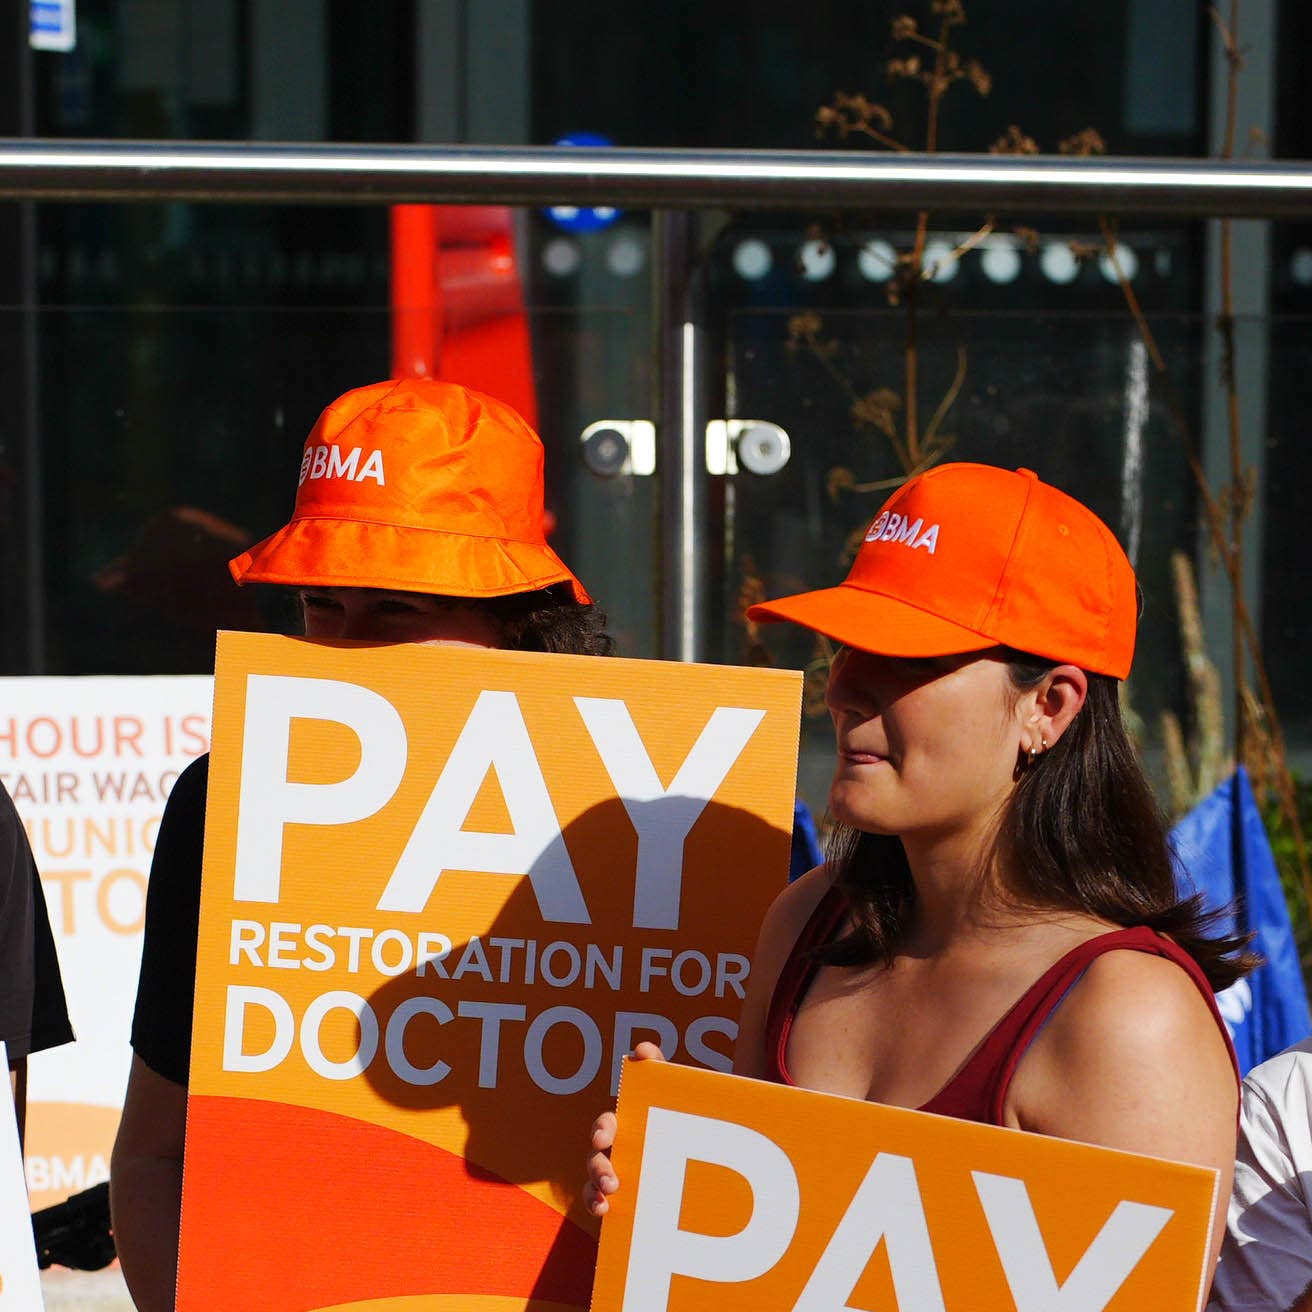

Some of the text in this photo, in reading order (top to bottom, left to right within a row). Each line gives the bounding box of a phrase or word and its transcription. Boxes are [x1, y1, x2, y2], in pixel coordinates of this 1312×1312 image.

[311, 444, 385, 487] BMA
[880, 513, 940, 555] BMA
[1, 771, 81, 804] AIR
[233, 674, 767, 930] PAY
[229, 919, 751, 999] RESTORATION FOR
[222, 985, 740, 1096] DOCTORS
